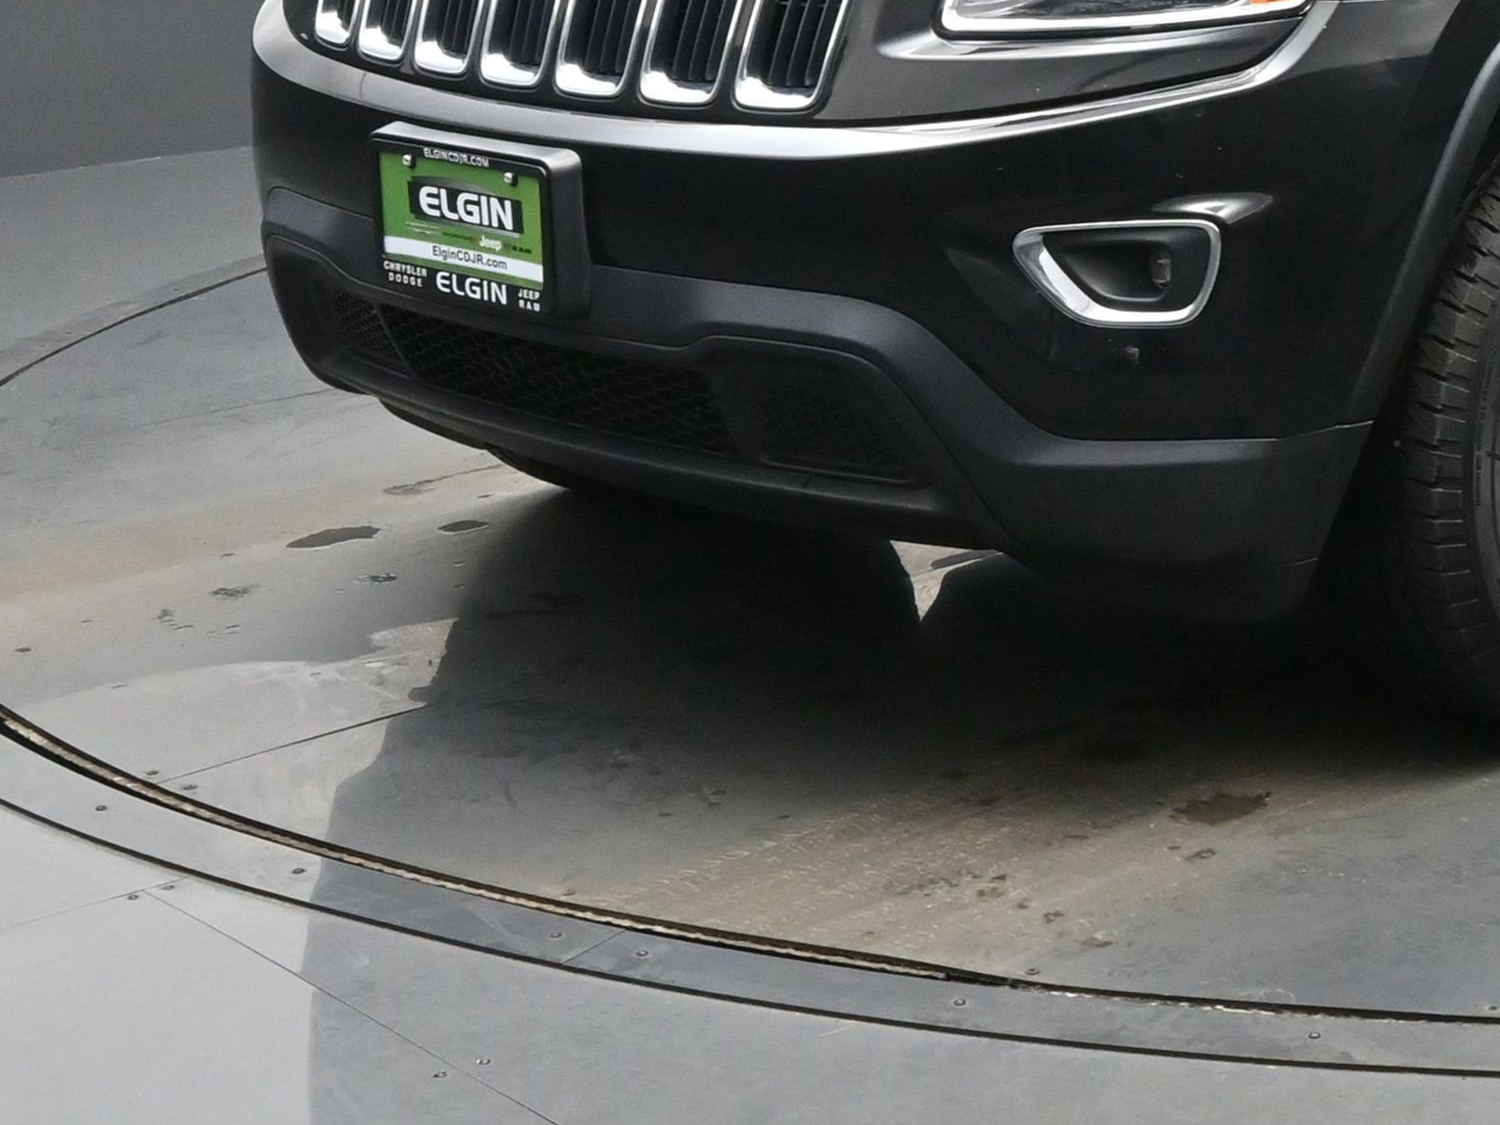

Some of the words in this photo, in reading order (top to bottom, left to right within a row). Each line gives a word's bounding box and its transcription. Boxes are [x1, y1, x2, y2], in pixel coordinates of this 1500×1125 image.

[423, 147, 490, 168] ELGINCDJR.COM
[419, 185, 514, 231] ELGIN
[432, 245, 508, 270] ElginCDJR.com
[383, 260, 428, 278] CHRYSLER
[388, 272, 423, 288] DODGE
[436, 271, 508, 305] ELGIN
[518, 288, 541, 301] JEEP
[518, 299, 541, 313] RAM
